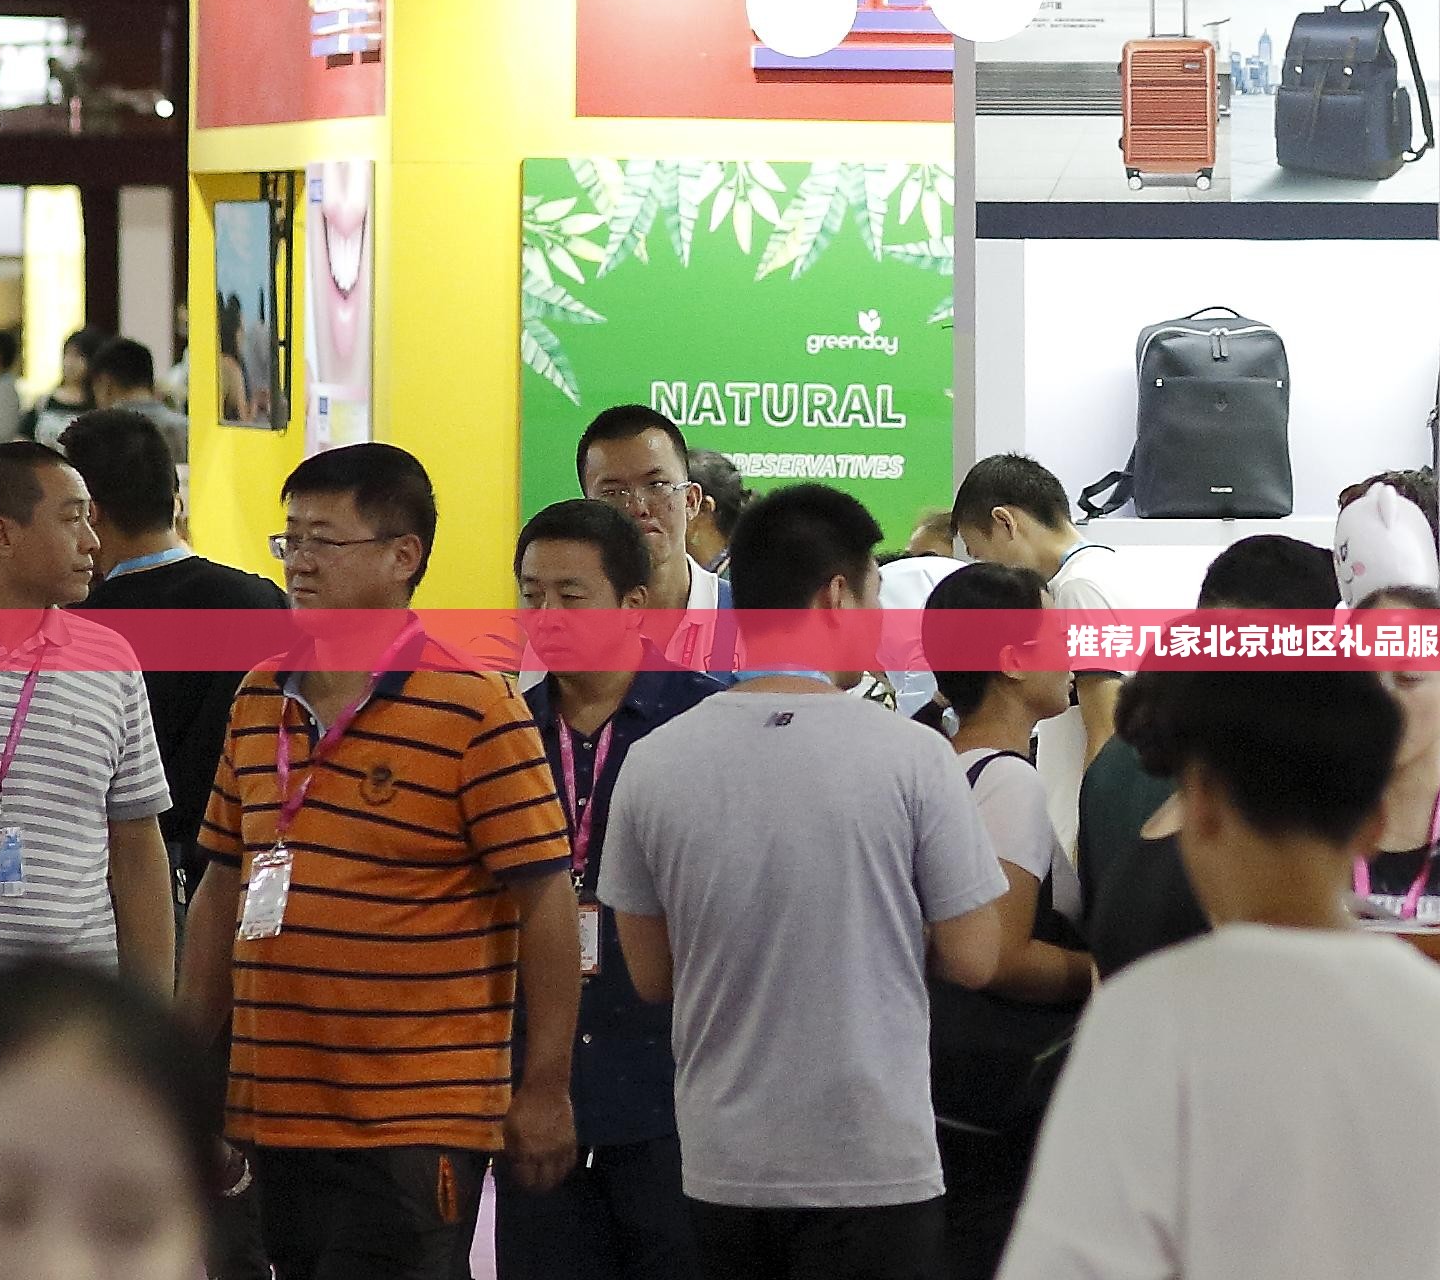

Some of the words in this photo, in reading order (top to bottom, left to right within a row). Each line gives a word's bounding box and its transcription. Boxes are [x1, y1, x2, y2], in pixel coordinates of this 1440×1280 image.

[806, 334, 898, 355] greenday
[651, 381, 907, 428] NATURAL
[721, 452, 905, 479] RESERVATIVES
